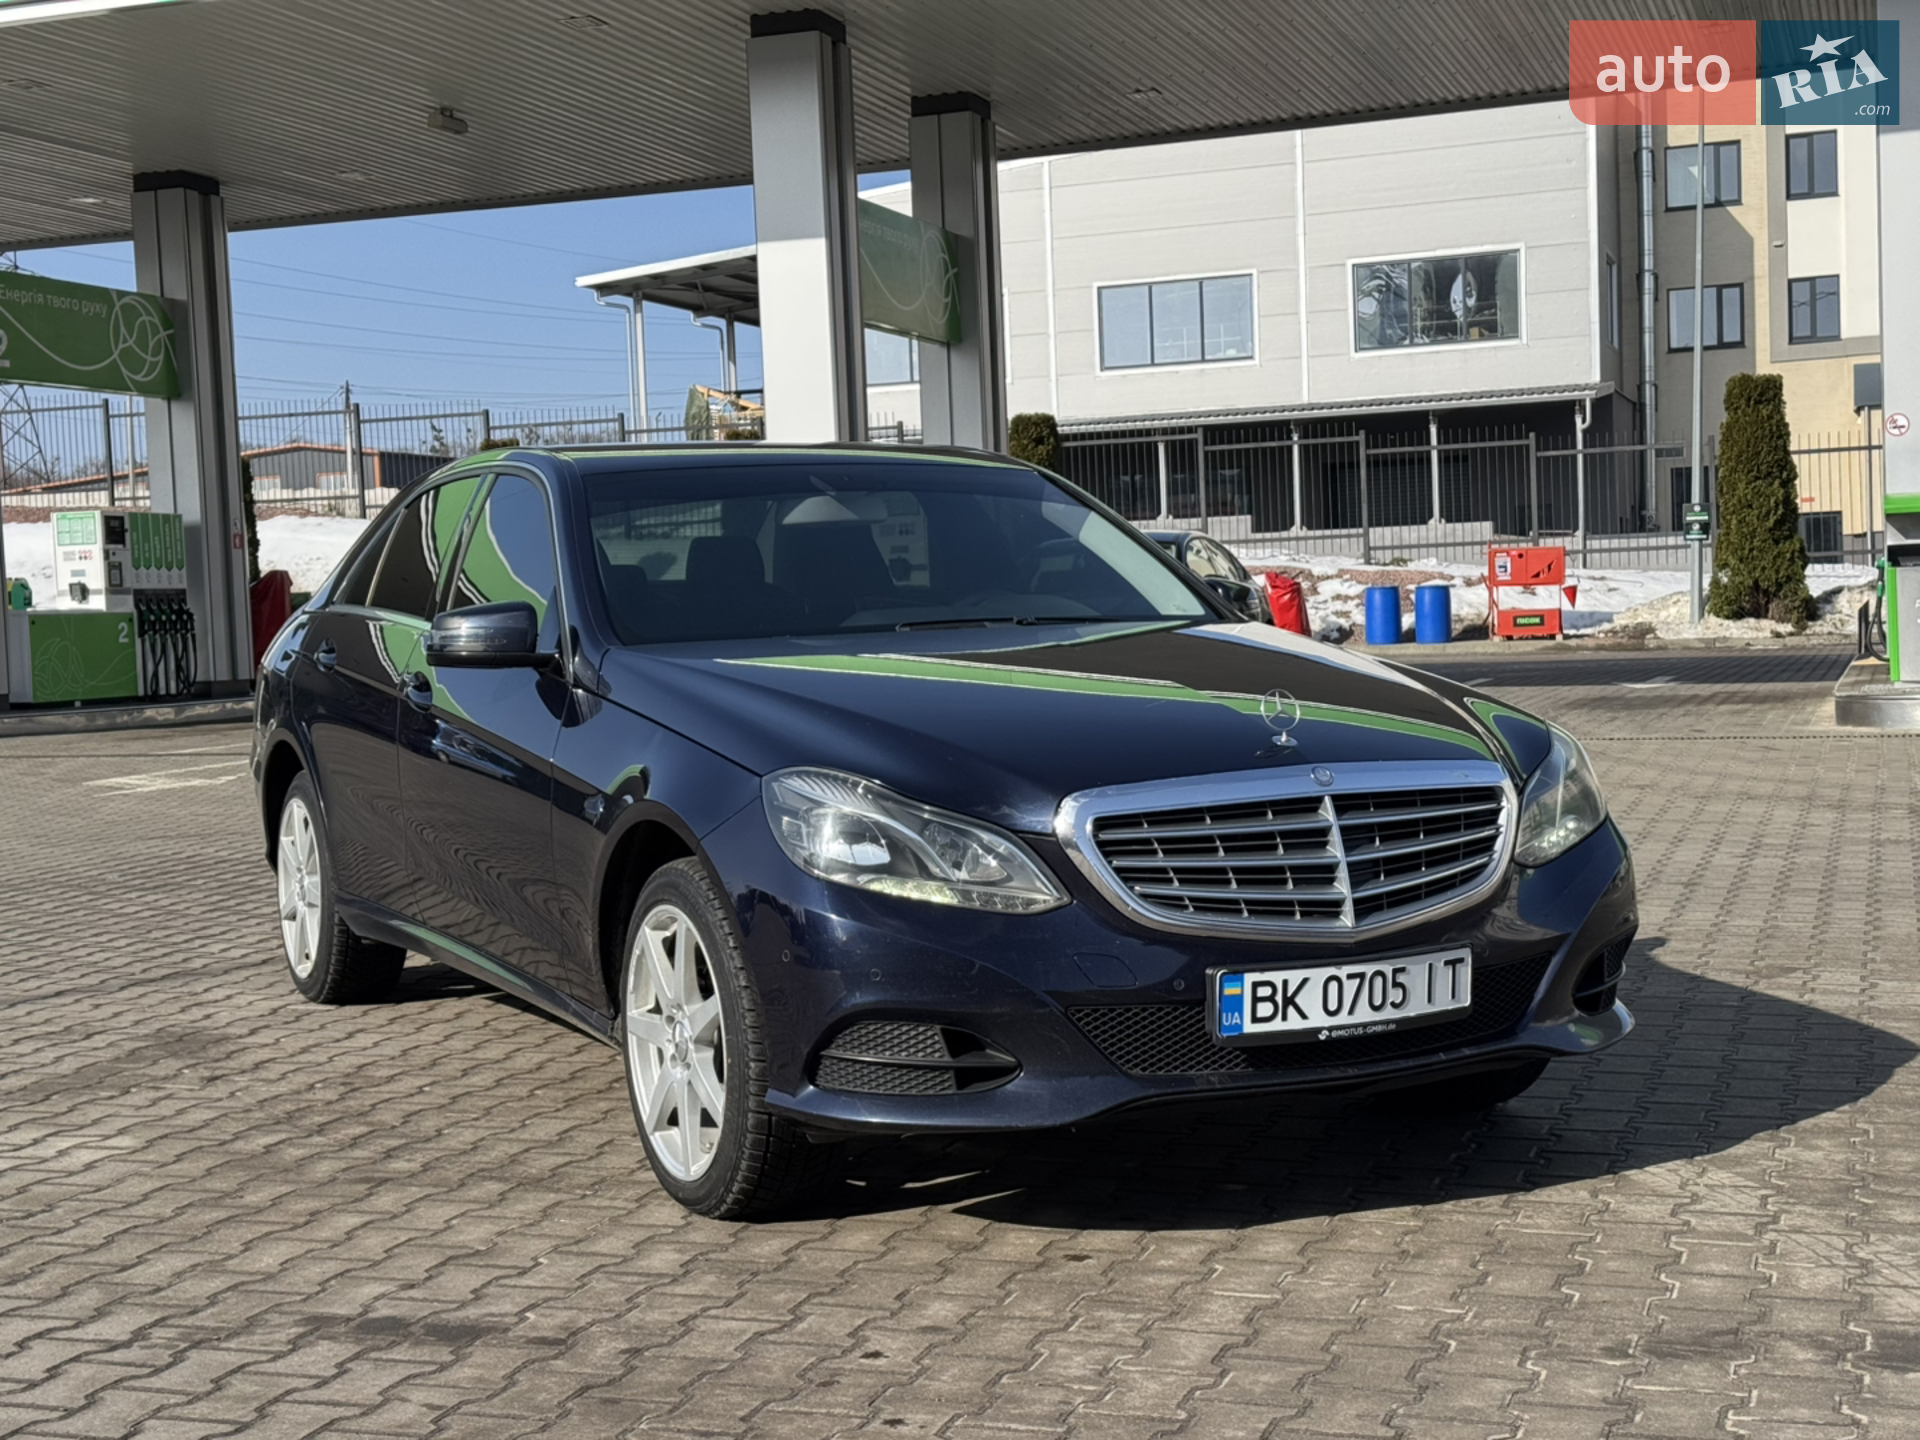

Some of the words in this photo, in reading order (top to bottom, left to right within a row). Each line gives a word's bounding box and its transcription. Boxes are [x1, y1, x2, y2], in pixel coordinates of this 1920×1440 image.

[46, 294, 80, 311] твого
[82, 300, 108, 318] руху
[118, 621, 129, 643] 2
[1250, 976, 1310, 1024] BK
[1322, 966, 1408, 1018] 0705
[1427, 957, 1466, 1004] IT
[1222, 1012, 1242, 1026] UA
